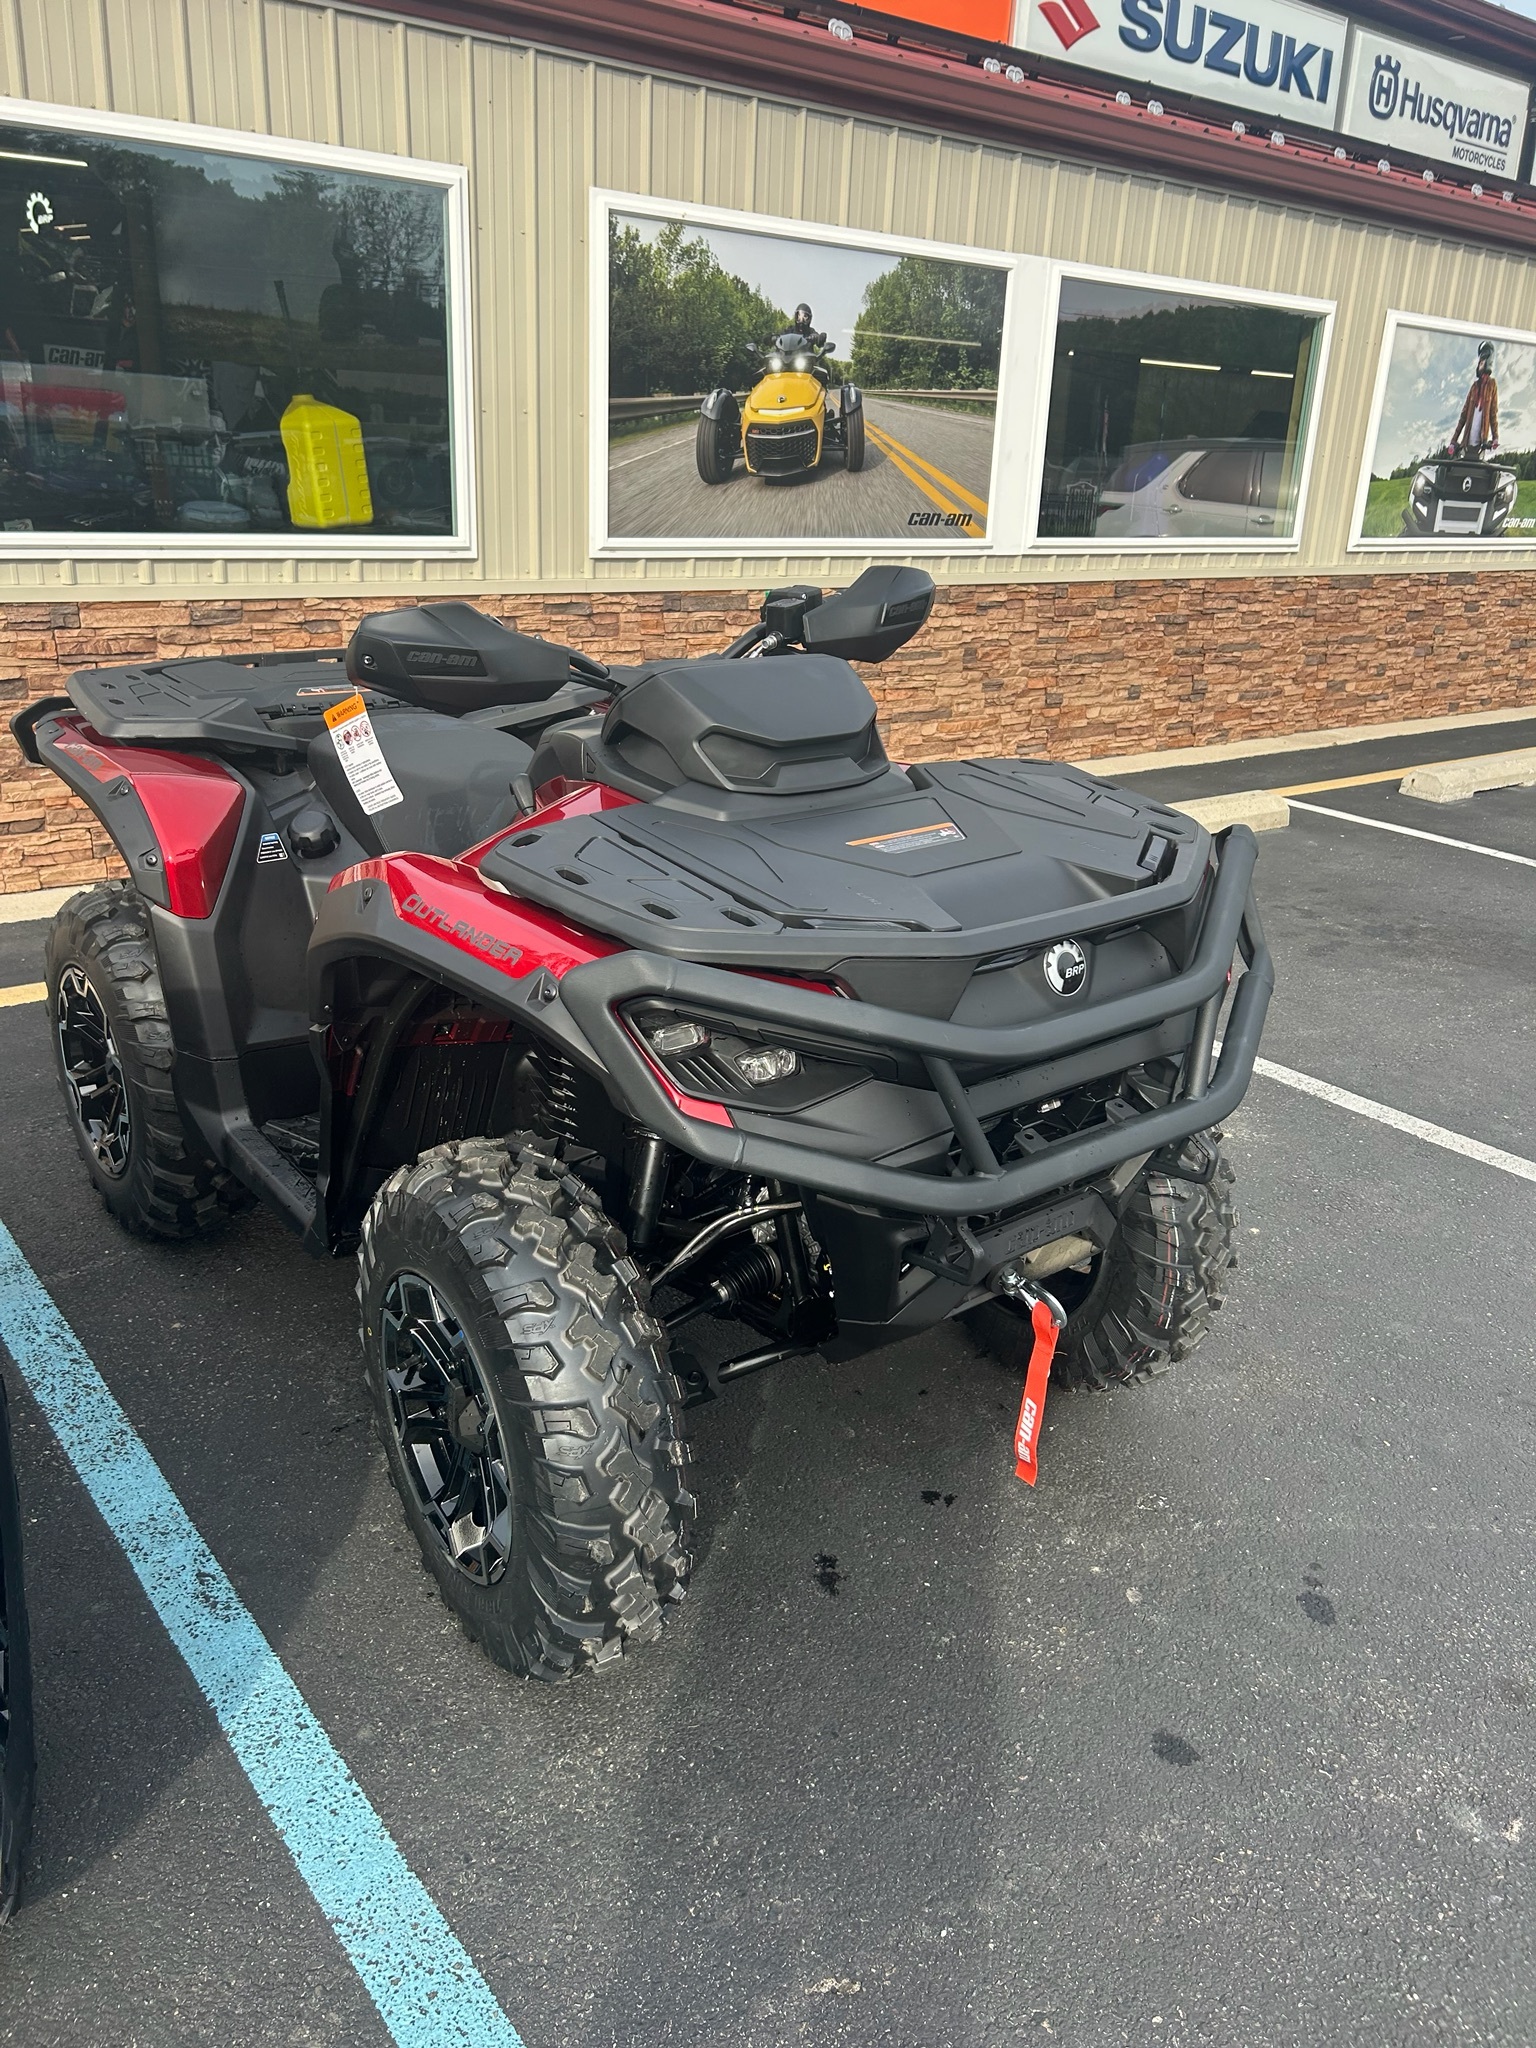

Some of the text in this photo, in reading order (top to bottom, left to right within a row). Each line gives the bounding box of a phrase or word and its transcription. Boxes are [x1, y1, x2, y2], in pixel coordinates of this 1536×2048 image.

[1118, 0, 1334, 104] SUZUKI
[1399, 78, 1512, 148] Husqvarna
[1452, 146, 1506, 172] MOTORCYCLES
[907, 512, 973, 527] can-am
[1502, 517, 1536, 528] can-am
[406, 651, 478, 667] can-am
[401, 894, 523, 966] OUTLANDER
[1065, 963, 1085, 979] BRP
[521, 1316, 556, 1337] XPS
[1017, 1397, 1037, 1464] can-am
[557, 1443, 595, 1459] XPS
